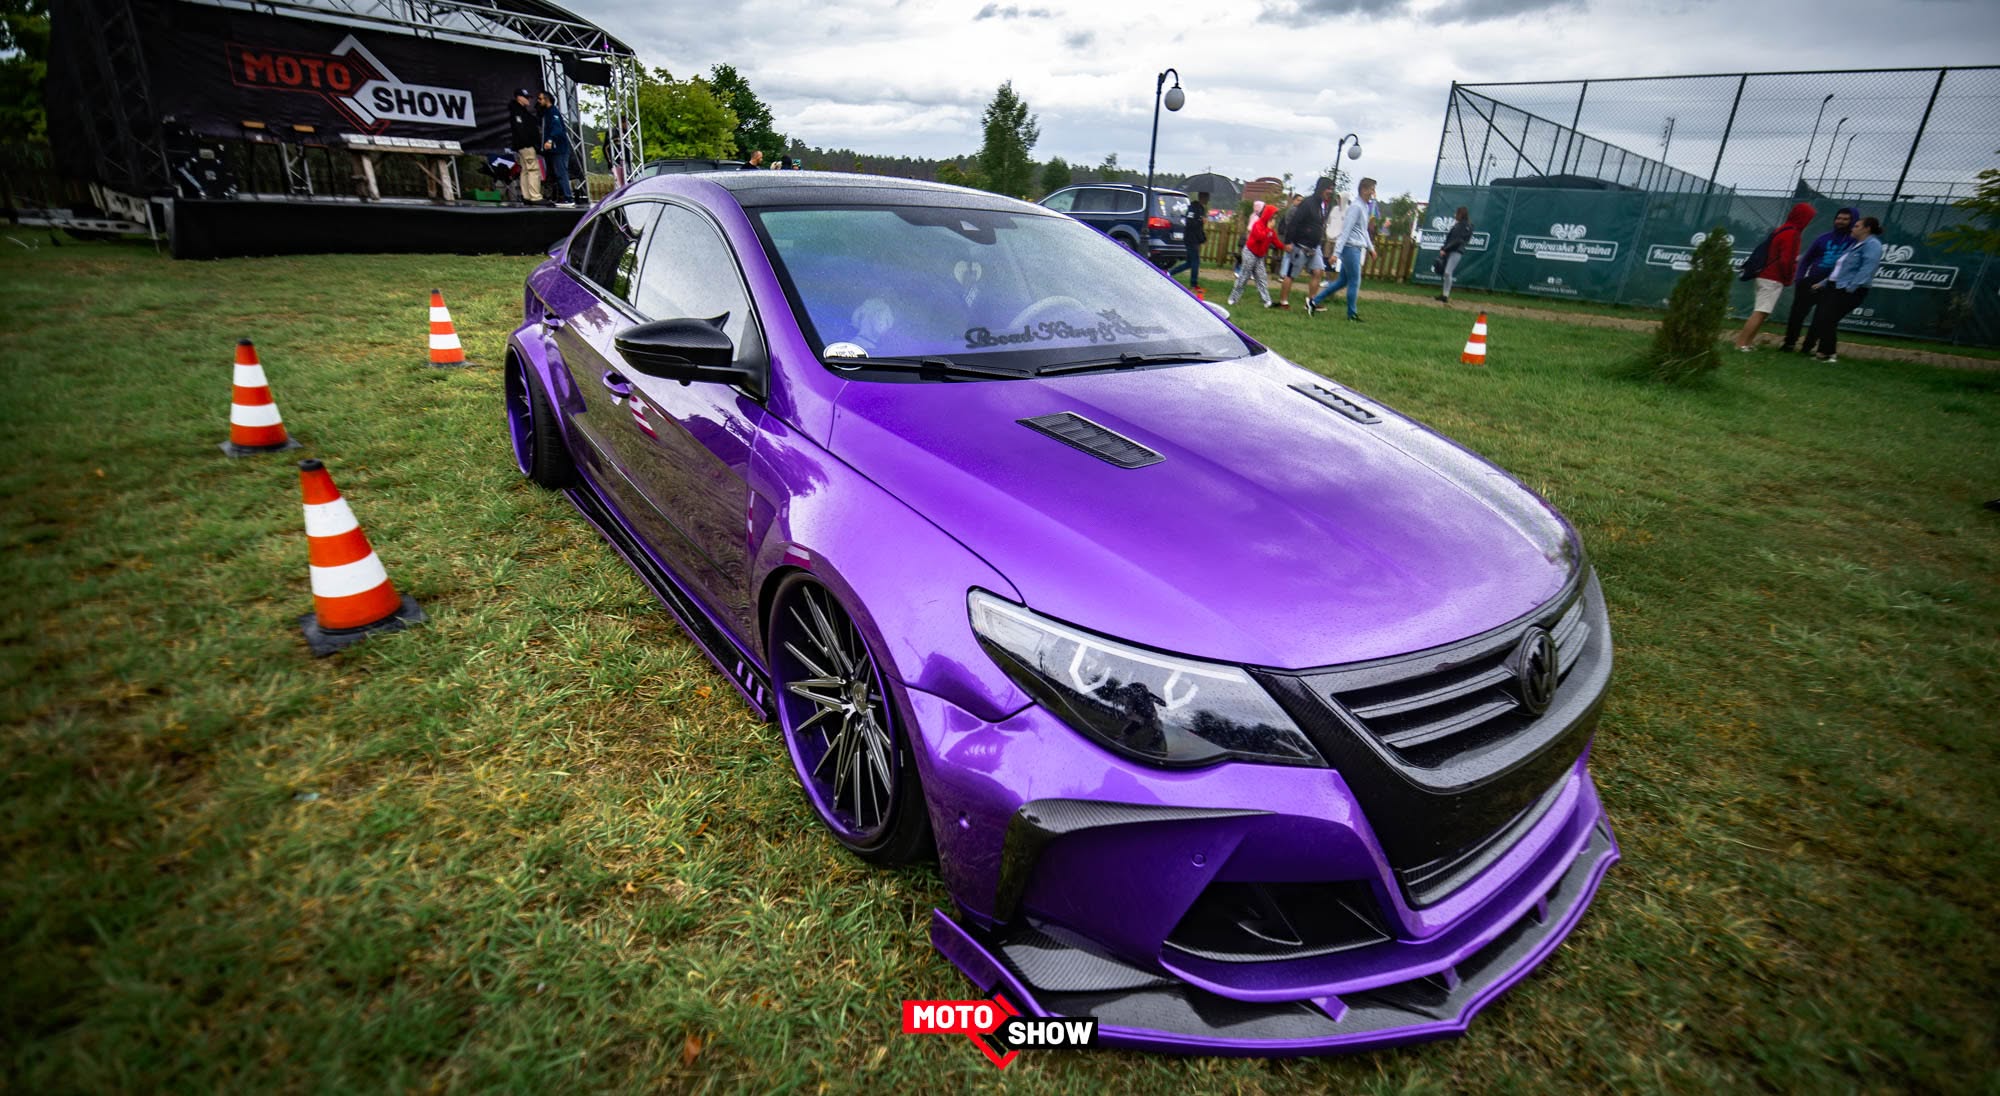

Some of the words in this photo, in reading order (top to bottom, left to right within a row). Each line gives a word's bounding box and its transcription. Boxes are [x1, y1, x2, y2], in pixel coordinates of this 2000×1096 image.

[241, 51, 350, 91] MOTO
[372, 86, 467, 120] SHOW
[1653, 248, 1693, 263] Kurpio
[1897, 267, 1950, 284] Kraina
[965, 325, 1036, 348] Road
[1034, 320, 1099, 343] King
